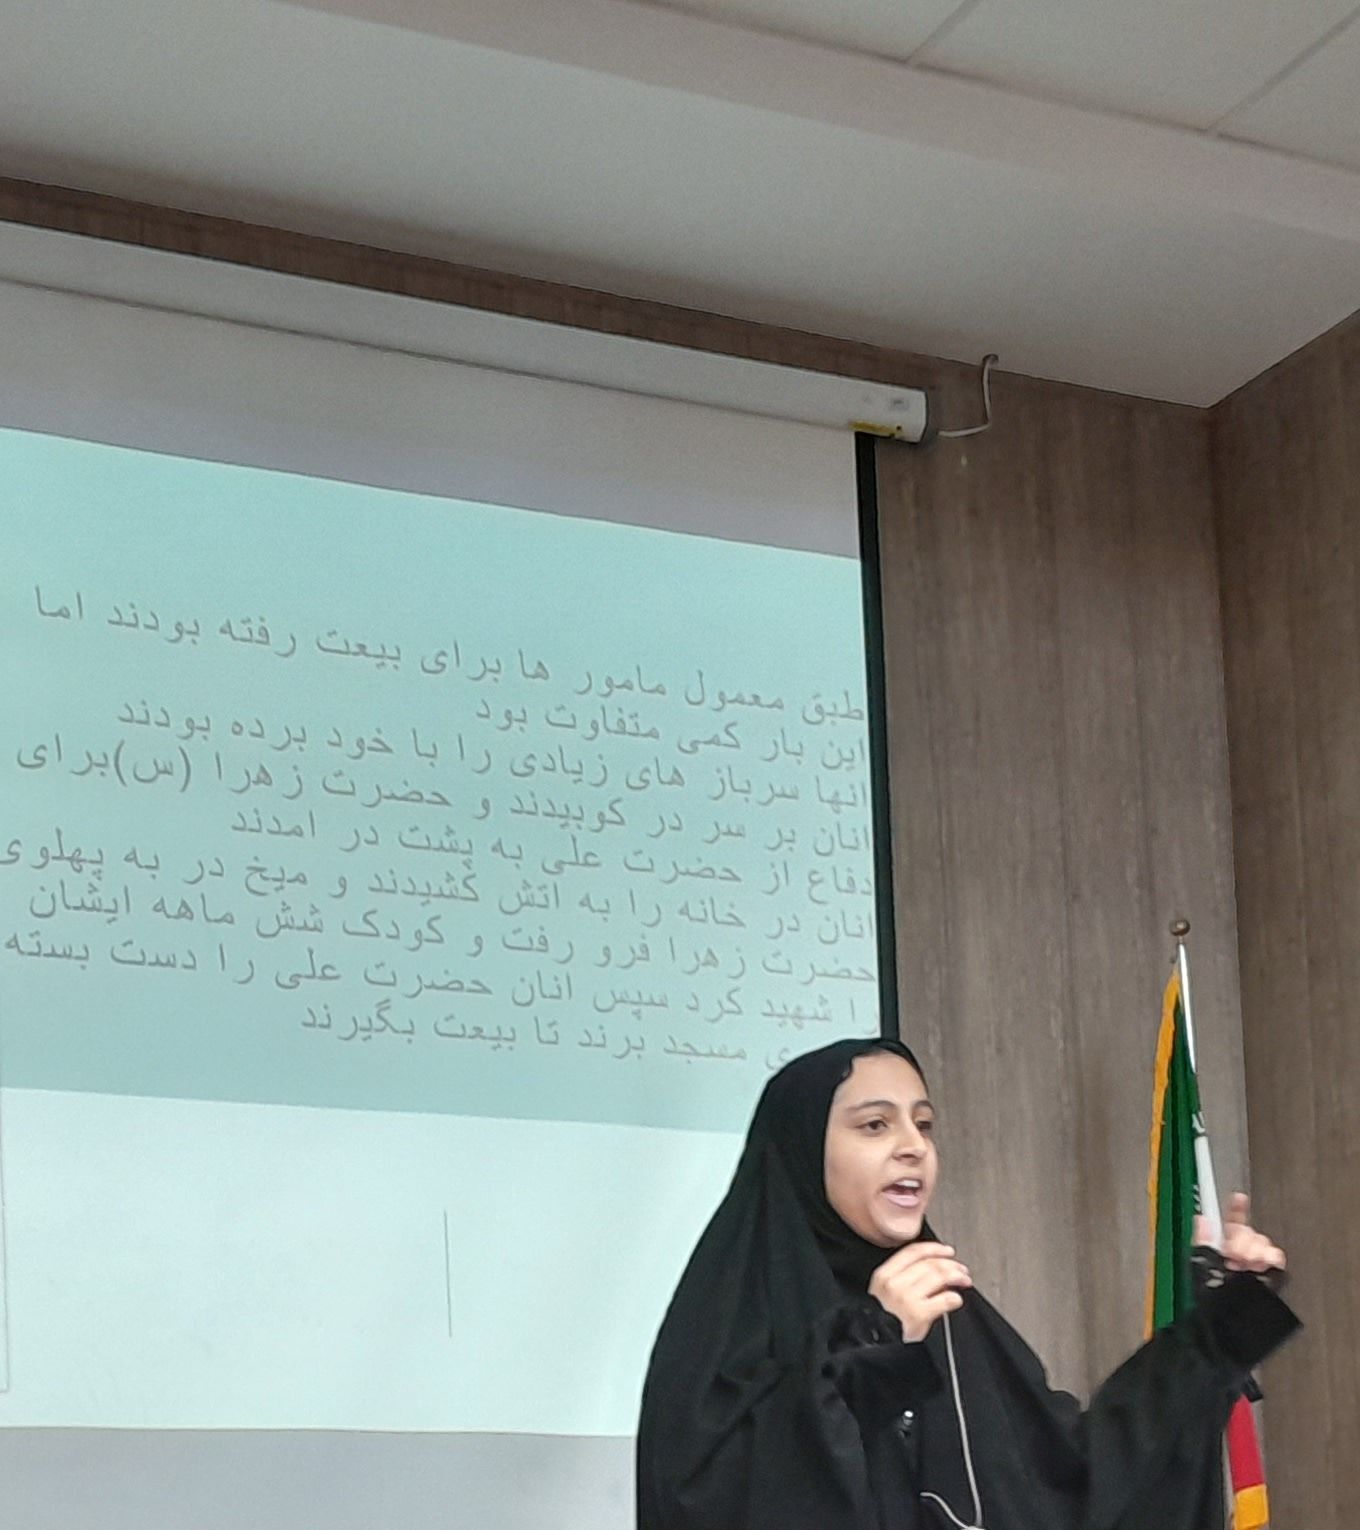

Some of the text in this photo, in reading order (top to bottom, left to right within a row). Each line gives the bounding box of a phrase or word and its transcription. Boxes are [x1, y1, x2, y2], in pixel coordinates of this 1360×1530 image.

[35, 585, 83, 620] اما
[107, 602, 201, 645] بودند
[219, 616, 297, 658] رفته
[316, 629, 401, 671] بیعت
[420, 640, 502, 682] برای
[518, 648, 550, 681] ها
[684, 669, 784, 712] معمول
[801, 689, 865, 726] طبق
[118, 699, 211, 741] بودند
[231, 717, 307, 752] برده
[476, 699, 866, 772] این بار کمی متفاوت بود
[326, 727, 394, 760] خود
[412, 727, 438, 768] با
[457, 733, 492, 774] را
[215, 751, 303, 800] زهرا
[509, 744, 608, 788] زیادی
[625, 756, 685, 791] های
[321, 769, 453, 808] حضرت
[815, 775, 868, 814] انها
[473, 798, 490, 820] و
[509, 790, 626, 834] کوبیدند
[646, 812, 683, 838] در
[702, 821, 746, 844] سر
[765, 827, 796, 852] بر
[813, 821, 870, 857] انان
[123, 847, 160, 880] به
[183, 857, 224, 885] در
[231, 807, 873, 905] دفاع از حضرت علی به پشت در امدند
[244, 855, 308, 897] میخ
[328, 875, 348, 899] و
[368, 868, 480, 907] کشیدند
[498, 878, 560, 916] اتش
[578, 893, 610, 922] به
[629, 888, 661, 927] را
[678, 896, 747, 928] خانه
[29, 878, 876, 985] حضرت زهرا فرو رفت و کودک شش ماهه ایشان
[765, 914, 800, 940] در
[817, 910, 873, 944] انان
[3, 930, 90, 971] بسته
[110, 939, 197, 971] دست
[218, 942, 255, 985] را
[274, 946, 341, 990] علی
[363, 961, 493, 999] حضرت
[511, 969, 572, 1007] انان
[300, 998, 416, 1045] بگیرند
[593, 989, 668, 1021] سپس
[686, 988, 744, 1023] کرد
[433, 1013, 516, 1051] بیعت
[534, 1016, 559, 1045] تا
[663, 1034, 747, 1064] مسجد
